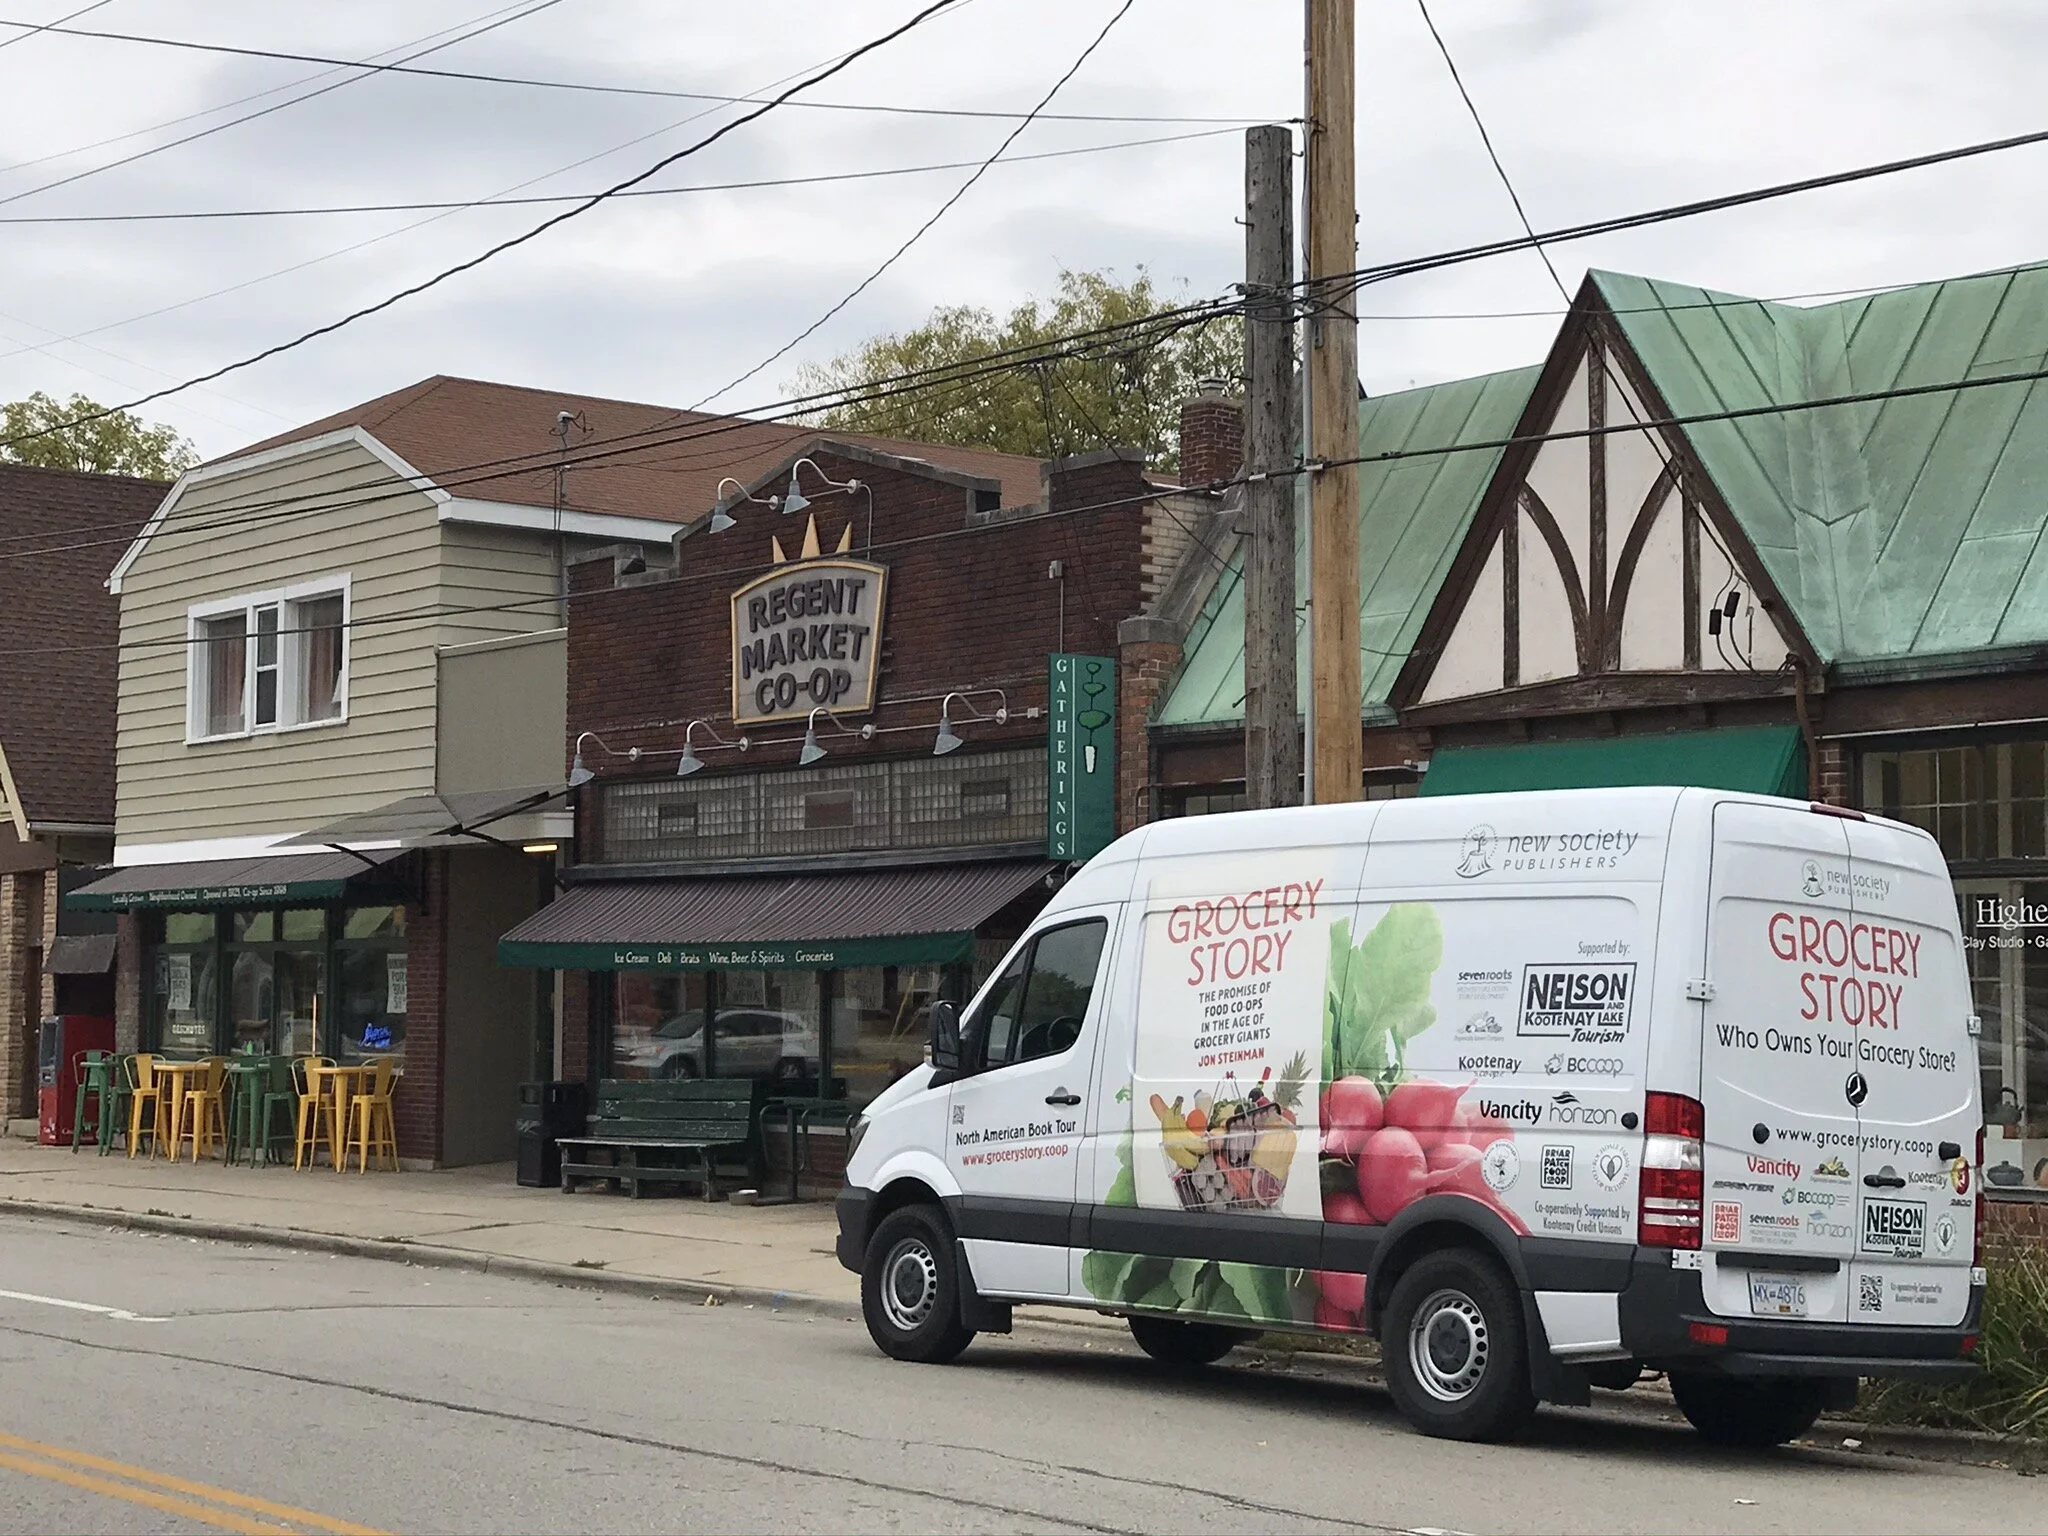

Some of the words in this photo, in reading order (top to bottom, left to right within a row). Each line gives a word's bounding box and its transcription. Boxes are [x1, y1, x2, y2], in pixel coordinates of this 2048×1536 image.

[748, 579, 866, 632] REGENT
[741, 624, 870, 680] MARKET
[755, 668, 851, 714] CO-OP
[1056, 659, 1068, 856] GATHERINGS
[1507, 834, 1551, 853] new
[1558, 829, 1639, 856] society
[1503, 856, 1618, 870] PUBLISHERS
[1827, 870, 1850, 884] new
[1853, 874, 1890, 895] society
[1828, 885, 1885, 901] PUBLISHERS
[1168, 878, 1324, 944] GROCERY
[1577, 939, 1618, 957] Supported
[1768, 912, 1921, 978] GROCERY
[1961, 935, 1986, 951] Clay
[1989, 935, 2025, 949] Studio
[2035, 935, 2048, 948] G
[614, 952, 626, 963] Ice
[626, 952, 650, 963] Cream
[657, 952, 672, 964] Deli
[680, 951, 701, 964] Brats
[758, 950, 786, 966] Spirits
[795, 950, 835, 963] Groceries
[1187, 929, 1293, 986] STORY
[1199, 990, 1216, 1004] THE
[1218, 983, 1257, 1001] PROMISE
[1259, 981, 1271, 994] OF
[1526, 973, 1628, 1010] NELSON
[1800, 972, 1903, 1030] STORY
[1205, 1003, 1229, 1018] FOOD
[1606, 1001, 1625, 1010] AND
[1201, 1021, 1210, 1033] IN
[1212, 1018, 1230, 1031] THE
[1232, 1015, 1251, 1029] AGE
[1252, 1013, 1264, 1026] OF
[1597, 1011, 1625, 1027] LAKE
[1194, 1033, 1235, 1049] GROCERY
[1236, 1027, 1271, 1043] GIANTS
[1571, 1028, 1626, 1044] Tourism
[1198, 1054, 1216, 1067] JON
[1218, 1047, 1265, 1065] STEINMAN
[1716, 1024, 1759, 1049] Who
[1765, 1028, 1813, 1054] Owns
[1817, 1033, 1853, 1059] Your
[1858, 1038, 1915, 1070] Grocery
[1919, 1046, 1956, 1073] Store?
[1458, 1055, 1523, 1074] Kootenay
[1480, 1099, 1543, 1125] Vancity
[956, 1130, 980, 1146] North
[983, 1125, 1025, 1142] American
[1028, 1121, 1052, 1137] Book
[1055, 1119, 1077, 1133] Tour
[1776, 1128, 1933, 1158] www.grocerystory.coop
[962, 1144, 1069, 1166] www.grocerystory.coop
[1746, 1155, 1801, 1182] Vancity
[1908, 1171, 1948, 1190] Kootenay
[1534, 1200, 1583, 1218] Co-operatively
[1584, 1203, 1620, 1219] Supported
[1621, 1206, 1631, 1222] by
[1866, 1205, 1923, 1234] NELSON
[1543, 1217, 1575, 1233] Kootenay
[1576, 1219, 1597, 1233] Credit
[1598, 1221, 1623, 1235] Unions
